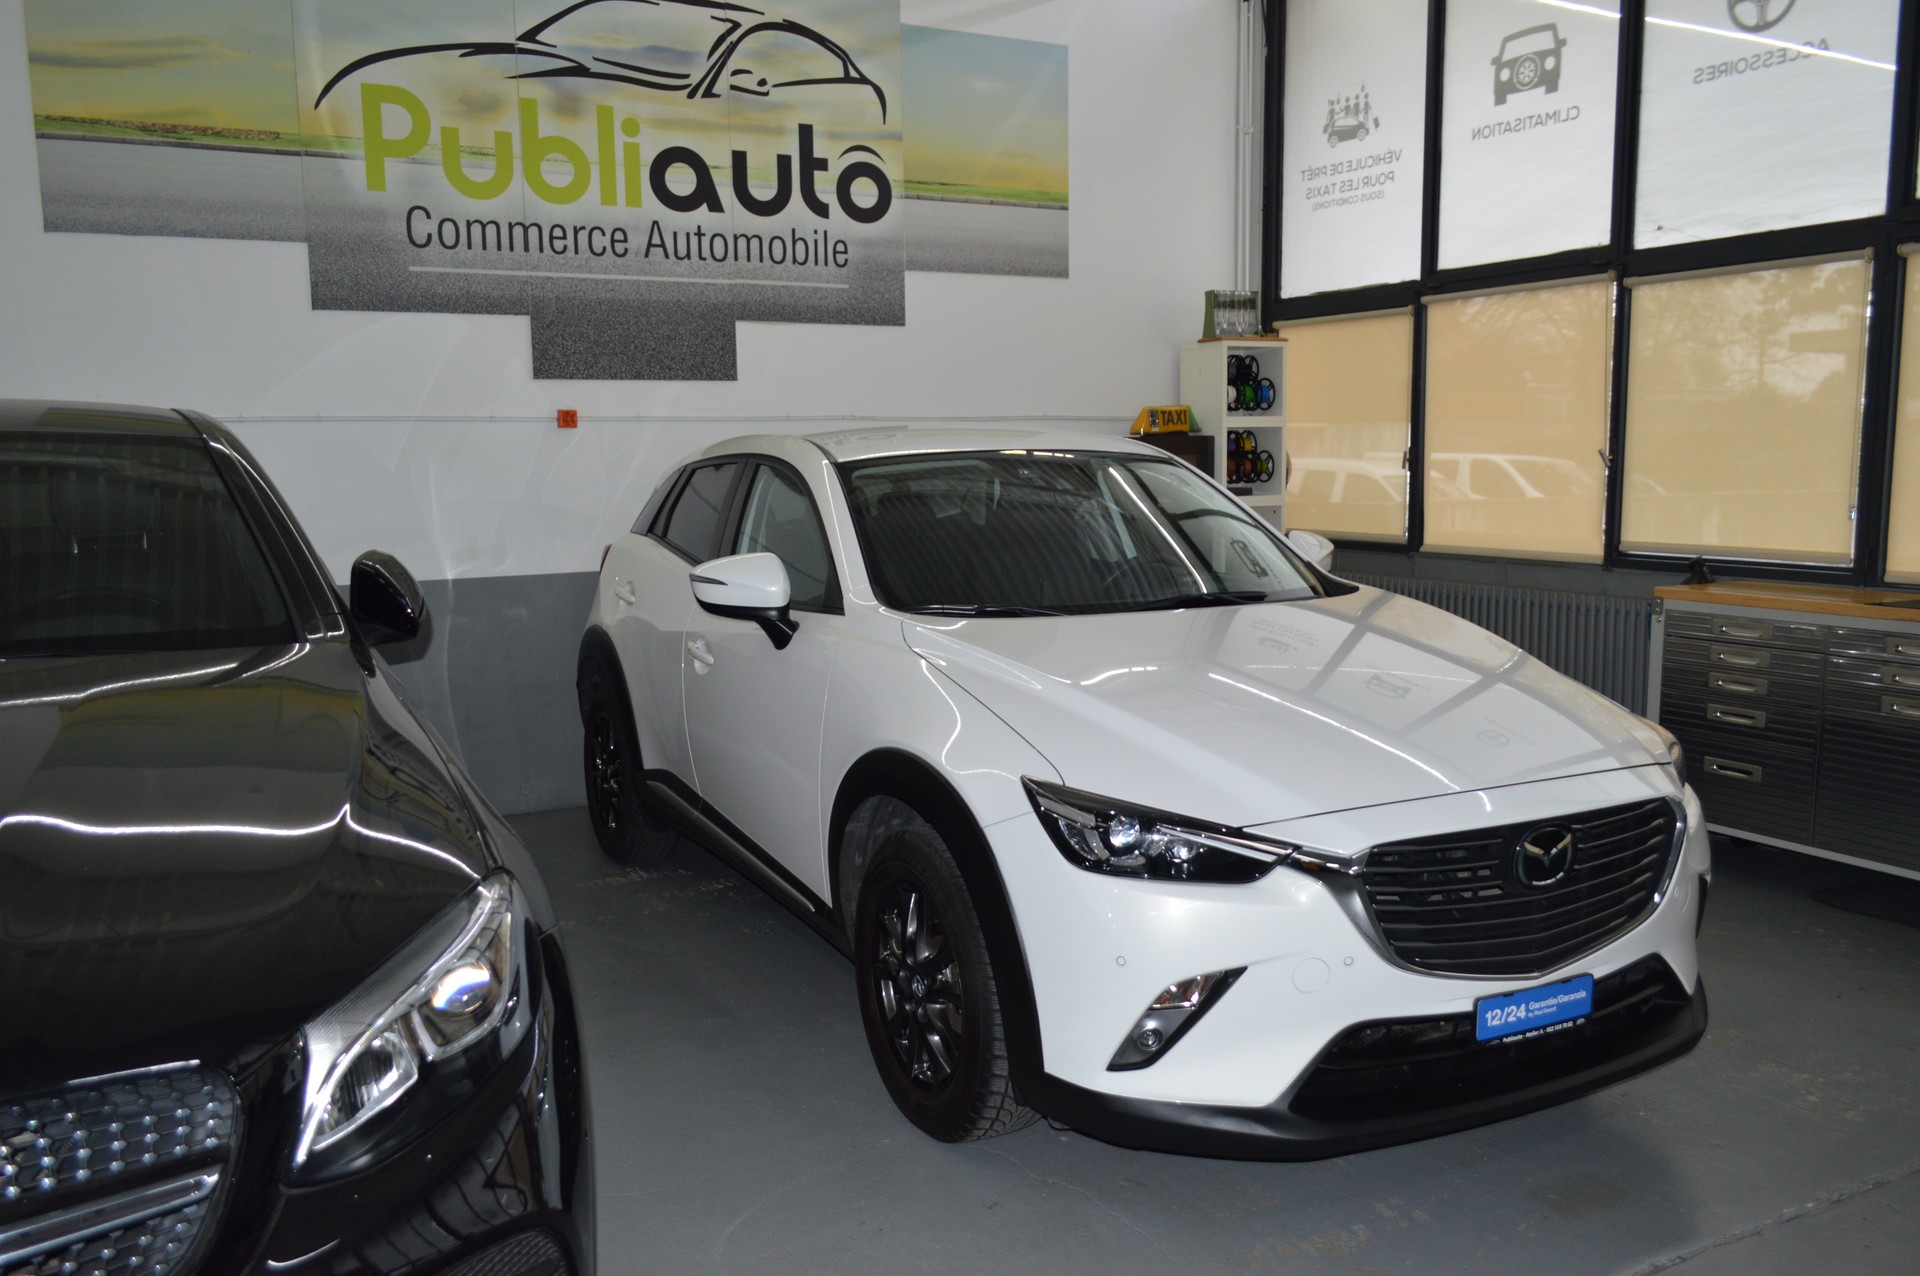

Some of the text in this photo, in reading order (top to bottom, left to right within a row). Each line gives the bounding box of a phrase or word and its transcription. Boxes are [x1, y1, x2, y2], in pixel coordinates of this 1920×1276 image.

[405, 205, 850, 269] Commerce Automobile
[1160, 409, 1187, 426] TAXI
[1485, 1003, 1526, 1027] 12/24
